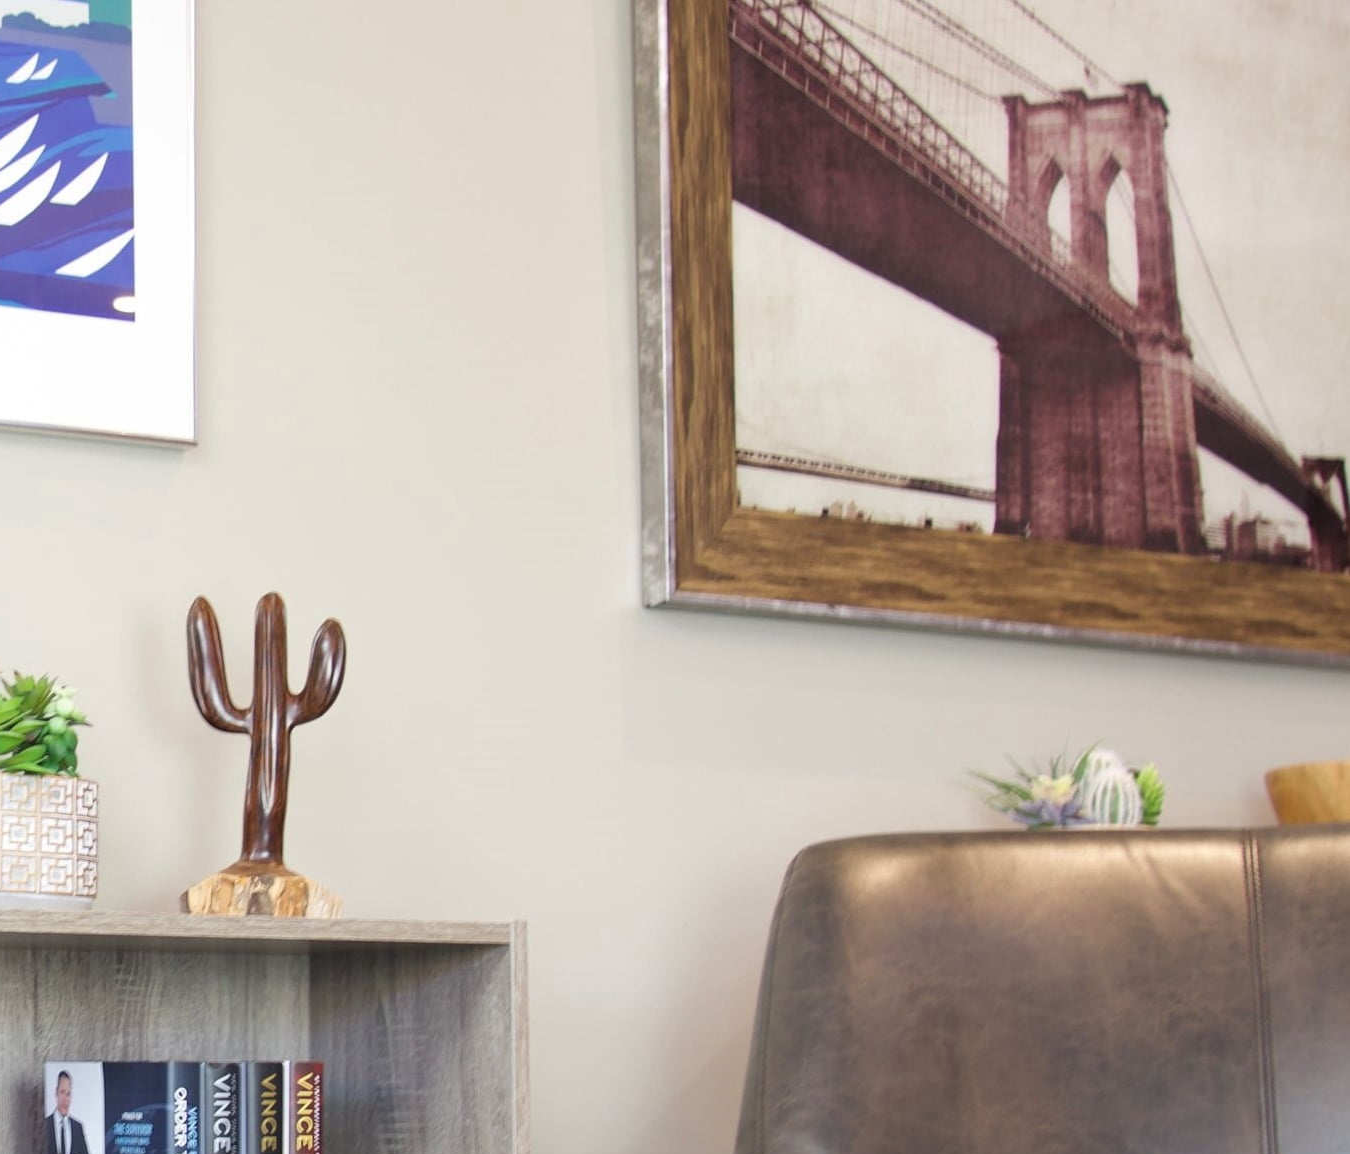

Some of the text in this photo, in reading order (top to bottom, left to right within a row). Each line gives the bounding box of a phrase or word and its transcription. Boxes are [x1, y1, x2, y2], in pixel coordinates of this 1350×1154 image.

[173, 1087, 188, 1147] ORDER
[187, 1106, 198, 1147] VINCE
[213, 1072, 231, 1154] VINCE
[260, 1072, 277, 1153] VINCE
[296, 1072, 314, 1152] VINCE
